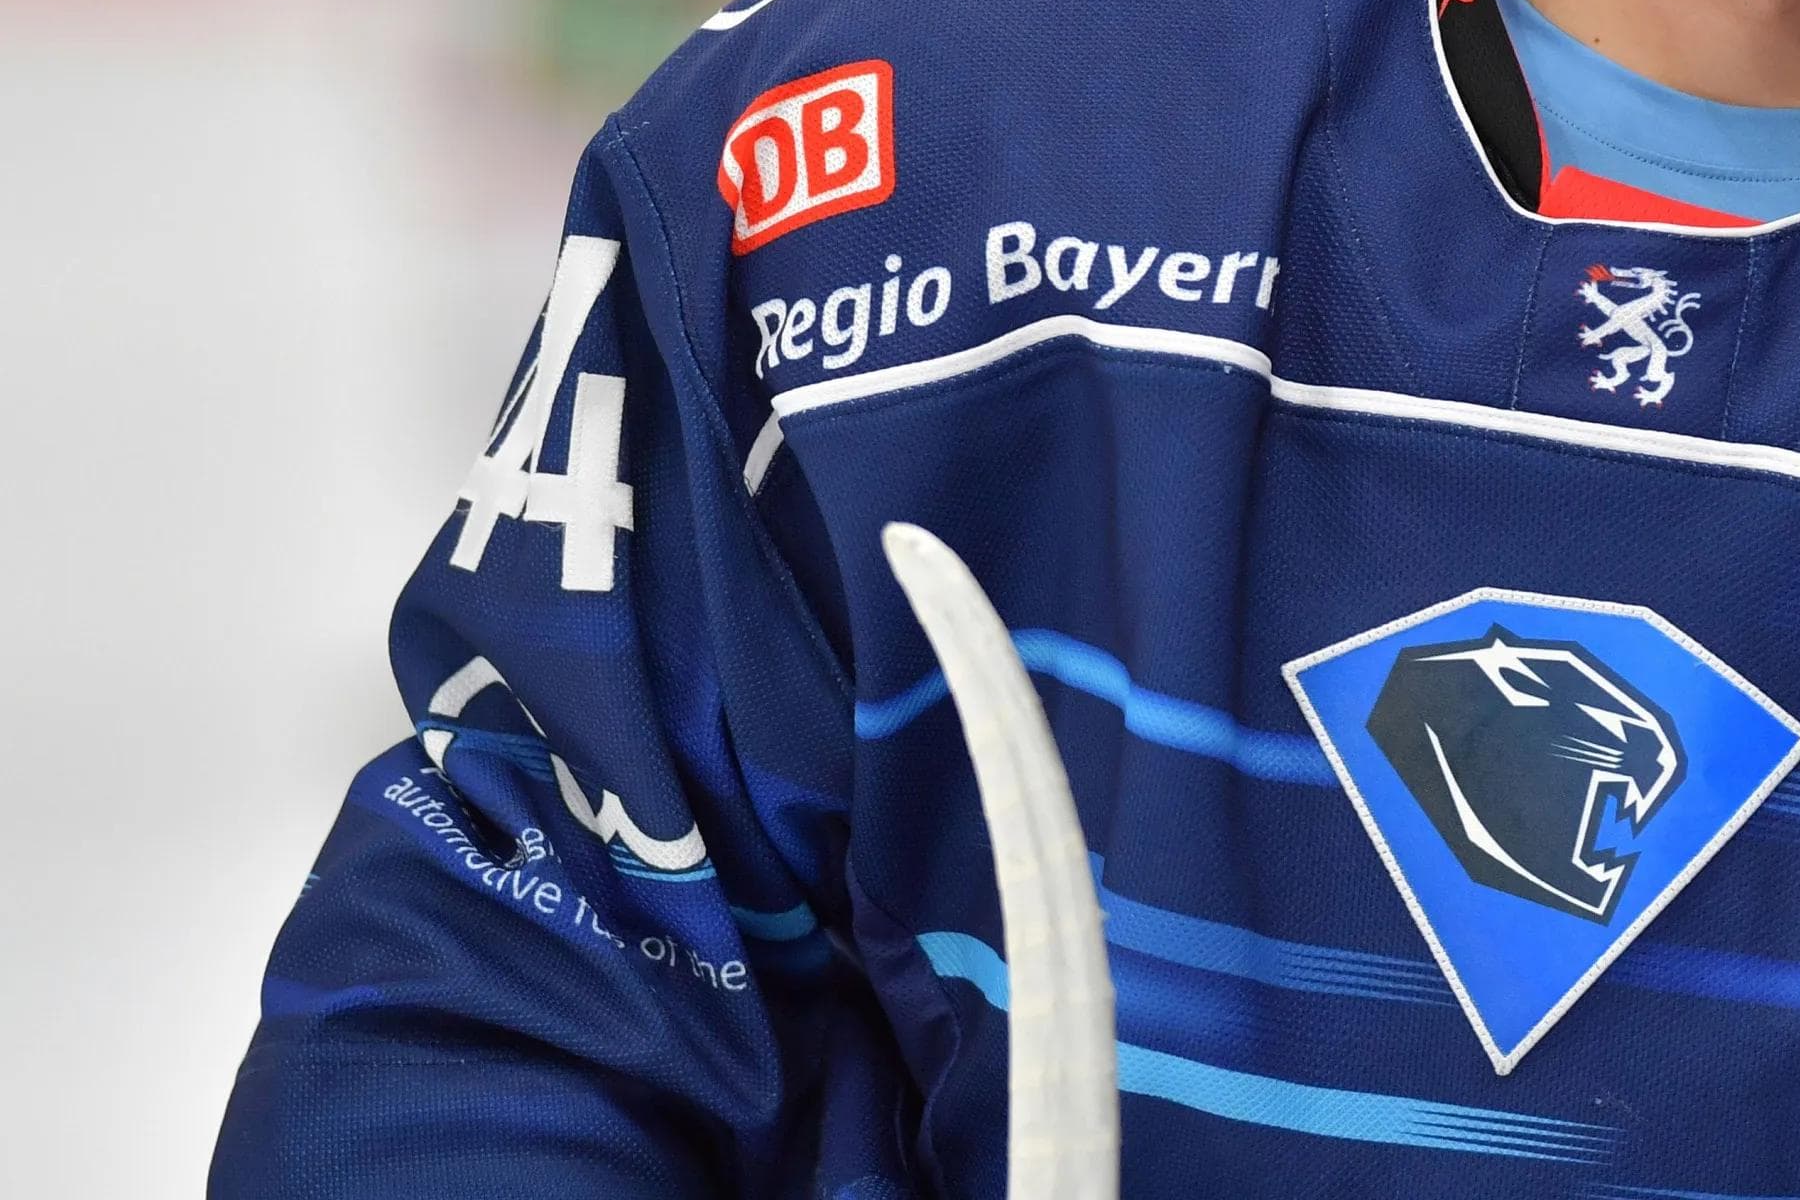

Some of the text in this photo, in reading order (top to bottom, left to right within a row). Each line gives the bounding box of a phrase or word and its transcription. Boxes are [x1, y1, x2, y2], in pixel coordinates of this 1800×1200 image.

[730, 88, 870, 231] DB
[751, 254, 953, 380] Regio
[449, 234, 634, 592] 44
